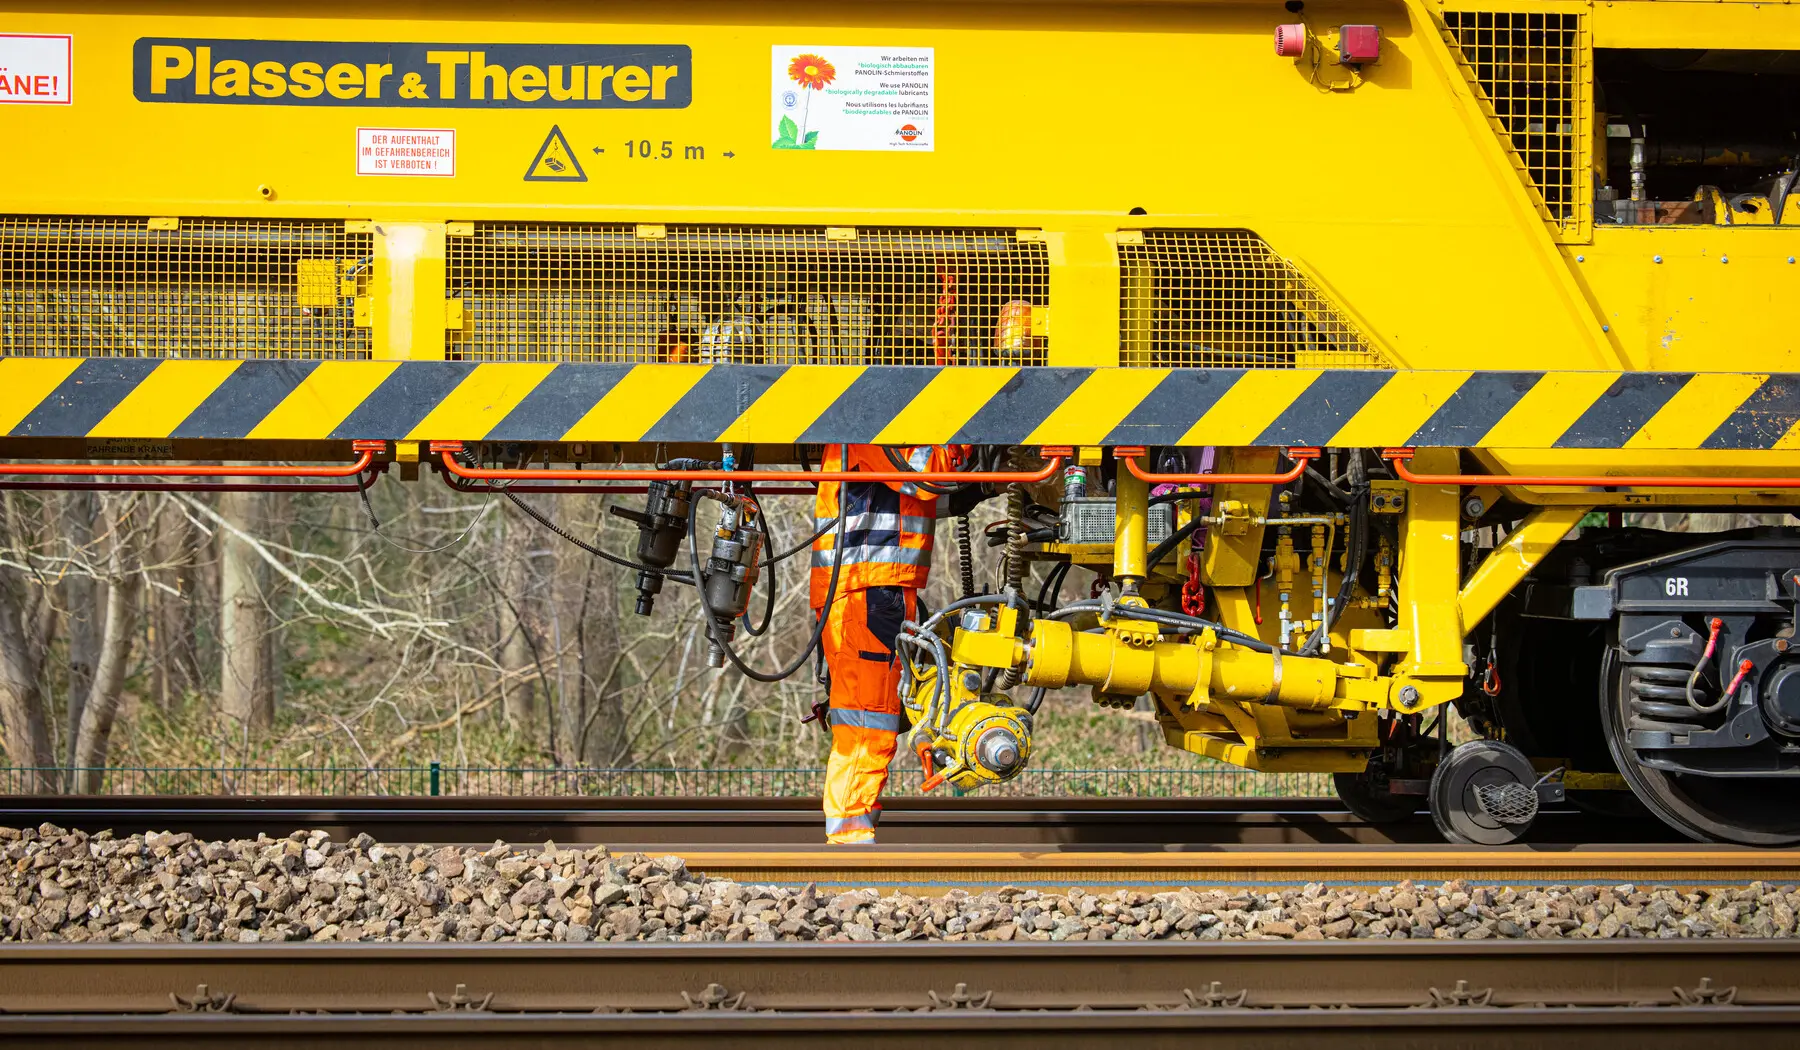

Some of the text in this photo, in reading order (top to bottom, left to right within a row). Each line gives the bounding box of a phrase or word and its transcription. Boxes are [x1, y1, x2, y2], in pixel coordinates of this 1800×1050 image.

[150, 44, 678, 102] Plasser & Theurer
[372, 134, 440, 146] DER AUFENTHALT
[362, 146, 450, 158] IM GEFAHRENBEREICH
[624, 140, 705, 160] 10.5 m
[375, 160, 388, 168] IST
[390, 160, 432, 170] VERBOTEN
[1666, 578, 1688, 596] 6R
